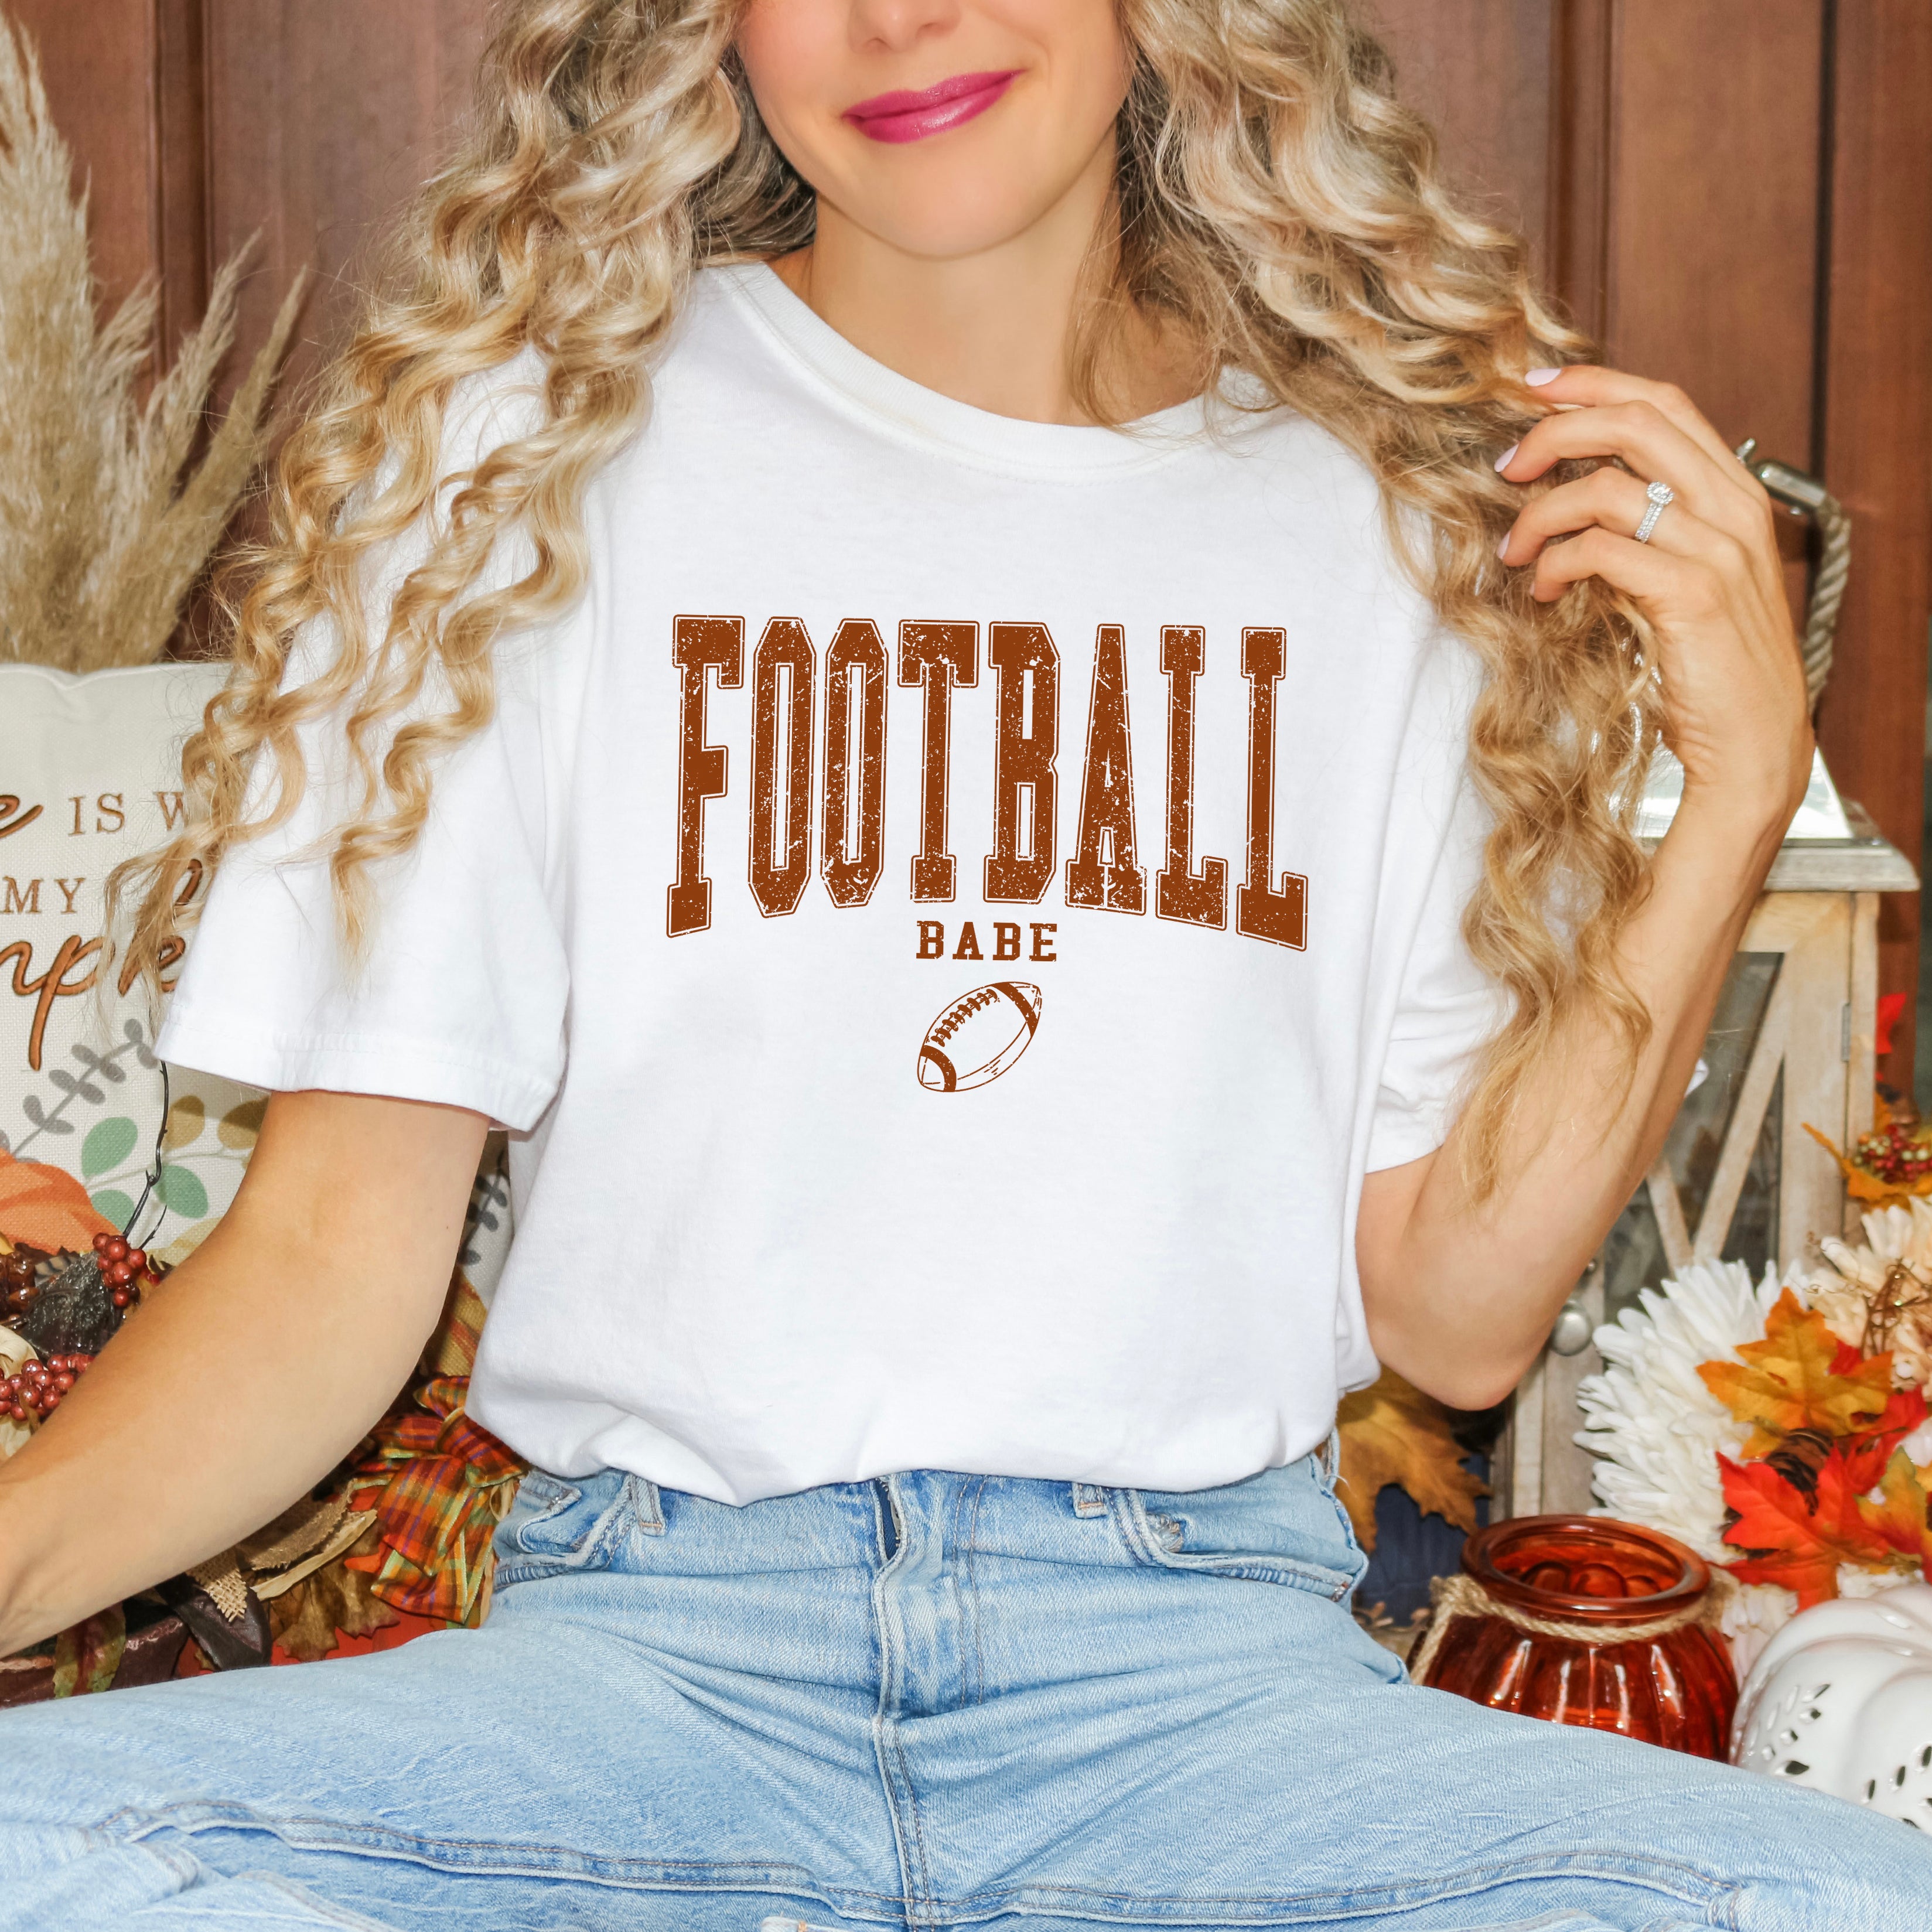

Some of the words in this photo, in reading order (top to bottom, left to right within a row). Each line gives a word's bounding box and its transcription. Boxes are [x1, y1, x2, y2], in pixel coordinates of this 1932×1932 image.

[667, 615, 1308, 951] FOOTBALL
[67, 792, 125, 837] IS
[0, 876, 86, 914] MY
[916, 920, 1057, 962] BABE
